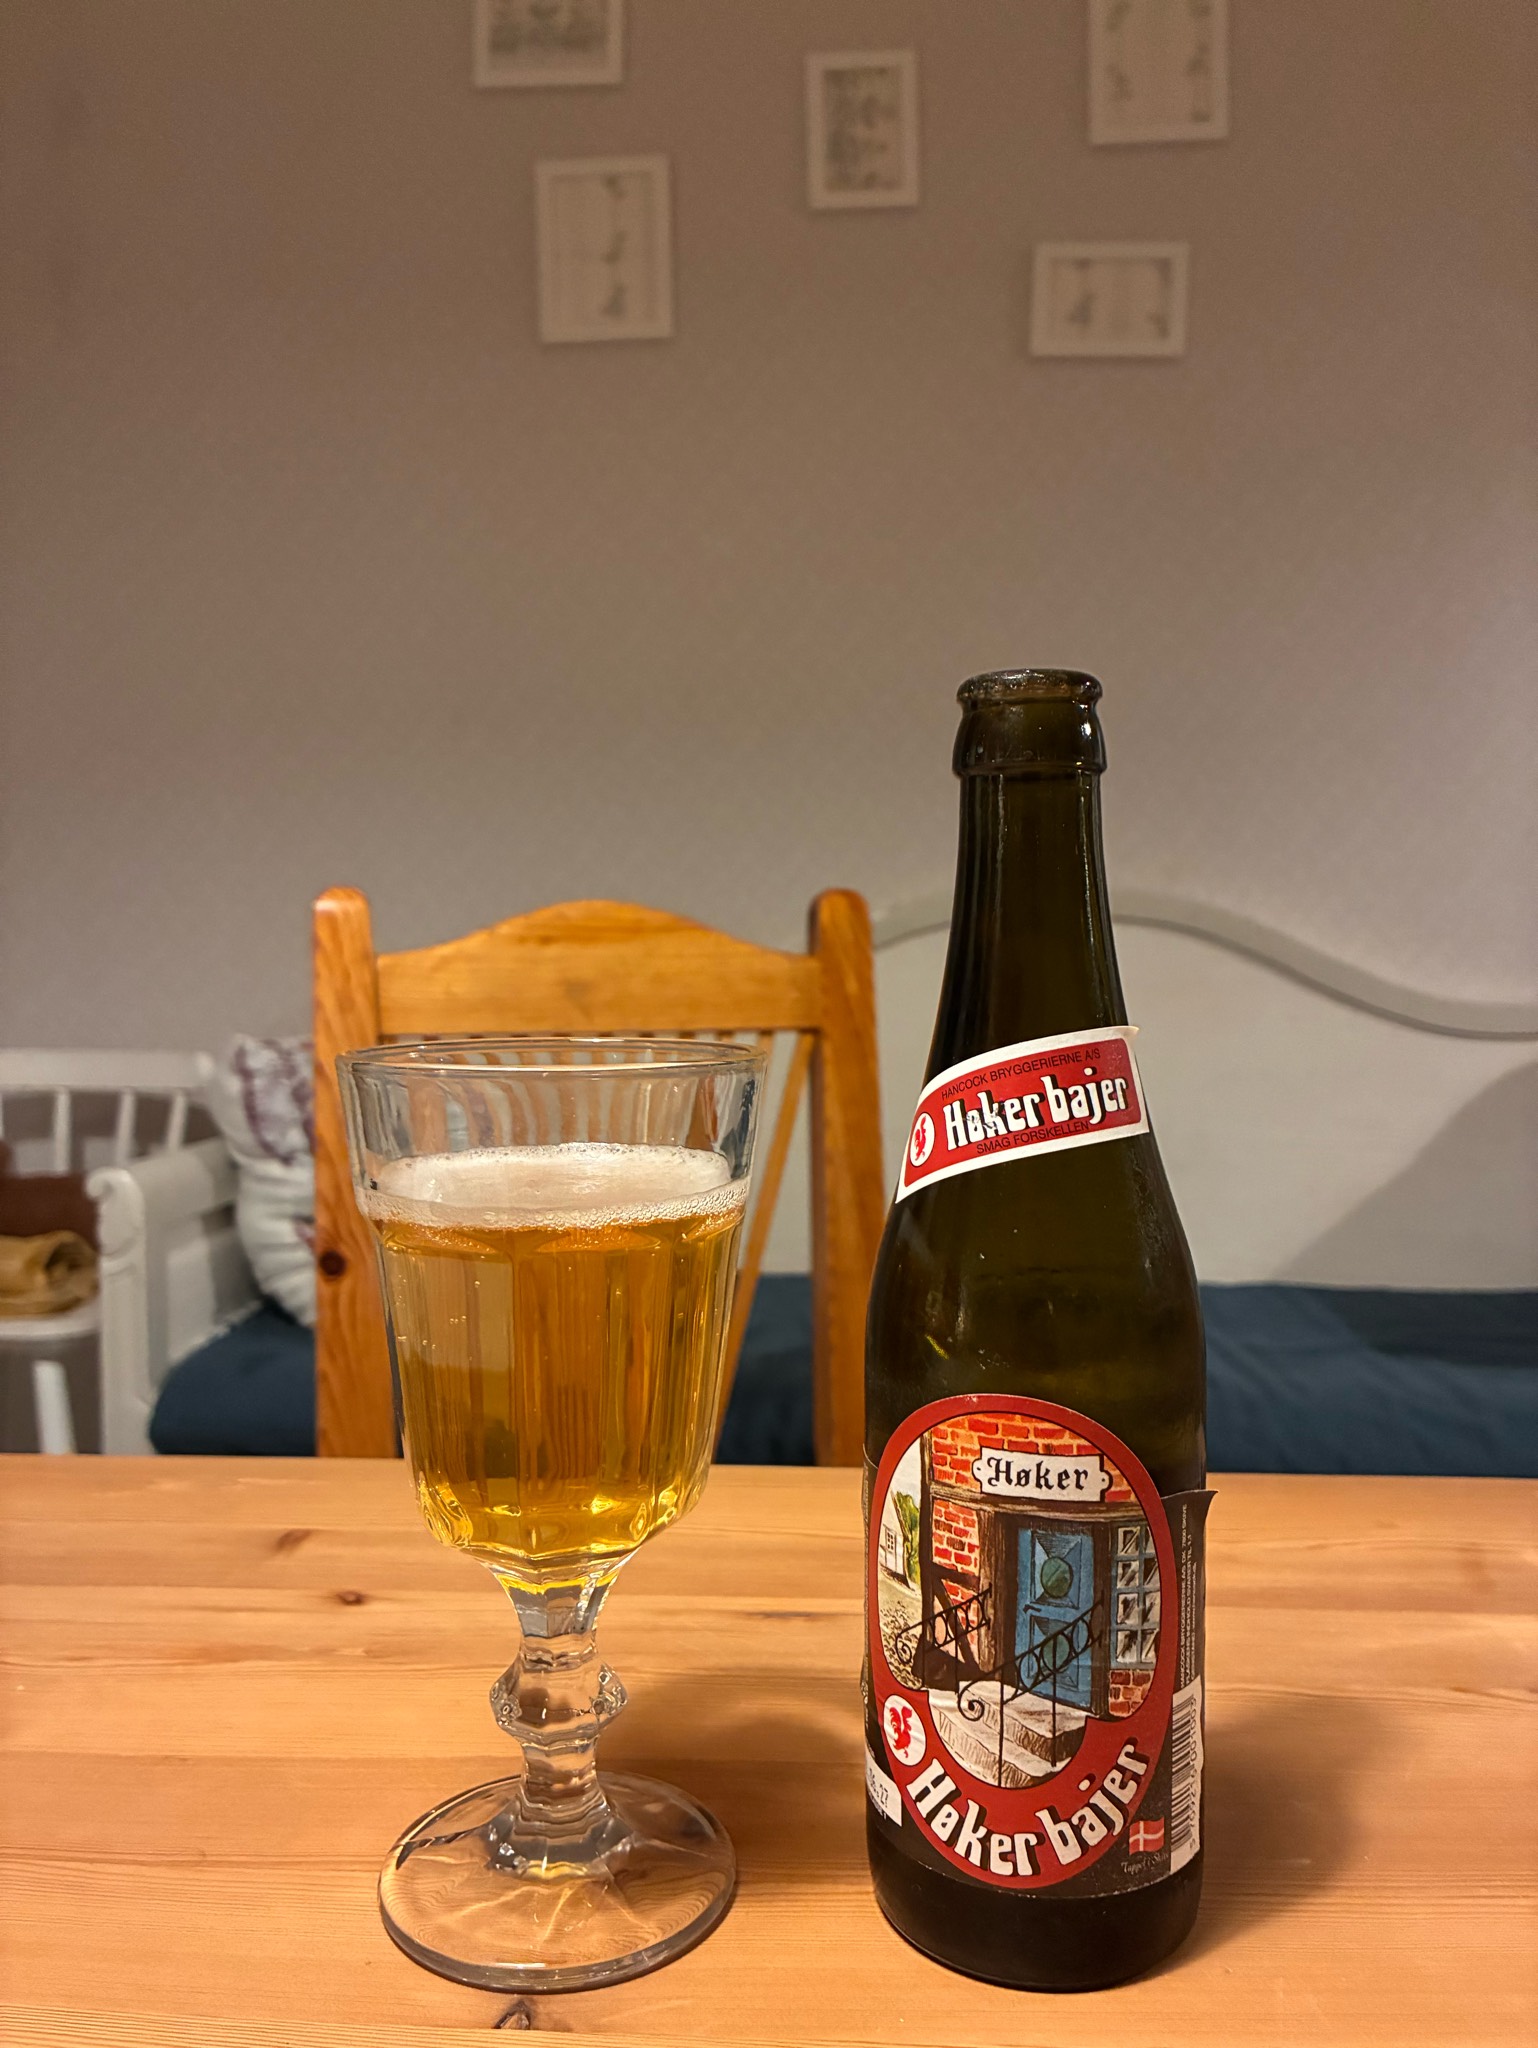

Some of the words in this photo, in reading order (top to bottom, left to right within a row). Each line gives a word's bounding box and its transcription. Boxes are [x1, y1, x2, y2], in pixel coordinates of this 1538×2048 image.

[941, 1073, 988, 1100] HANCOCK
[989, 1050, 1081, 1083] BRYGGERIERNE
[1085, 1048, 1101, 1061] A/S
[1040, 1067, 1127, 1124] bajer
[976, 1138, 1011, 1155] SMAG
[1013, 1121, 1089, 1145] FORSKELLEN
[986, 1456, 1089, 1491] Høker
[1035, 1739, 1149, 1866] bajer
